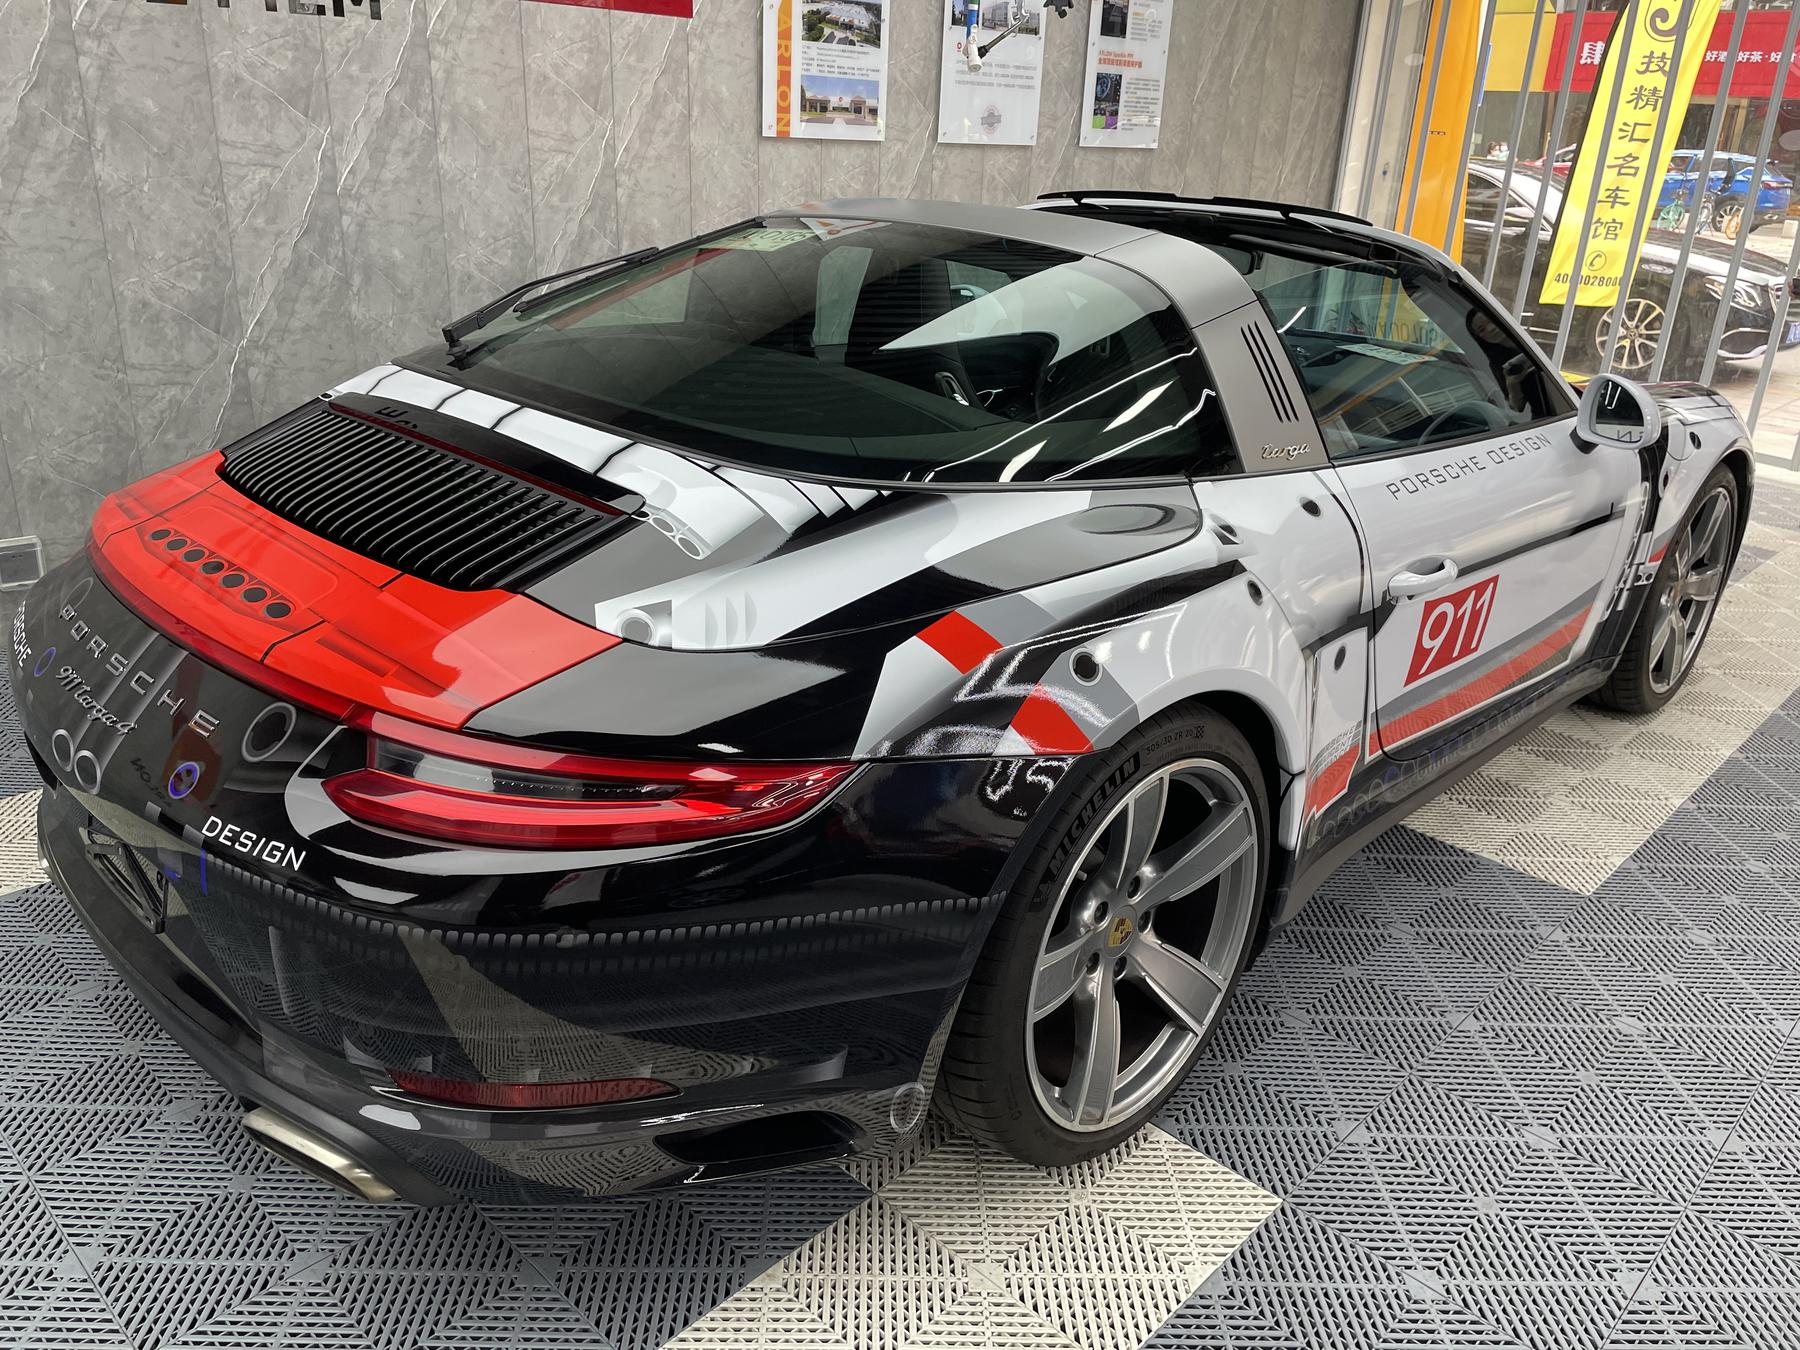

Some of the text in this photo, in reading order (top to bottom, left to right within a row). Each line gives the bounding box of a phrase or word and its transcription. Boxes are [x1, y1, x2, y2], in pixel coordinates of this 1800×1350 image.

[1592, 50, 1671, 241] 技精汇名车馆
[1554, 273, 1621, 287] 4002800
[1386, 433, 1552, 500] PORSCHE DESIGN
[59, 604, 220, 738] PORSCHE
[1418, 582, 1494, 675] 911
[202, 815, 306, 871] DESIGN
[1051, 757, 1137, 874] MICHELIN
